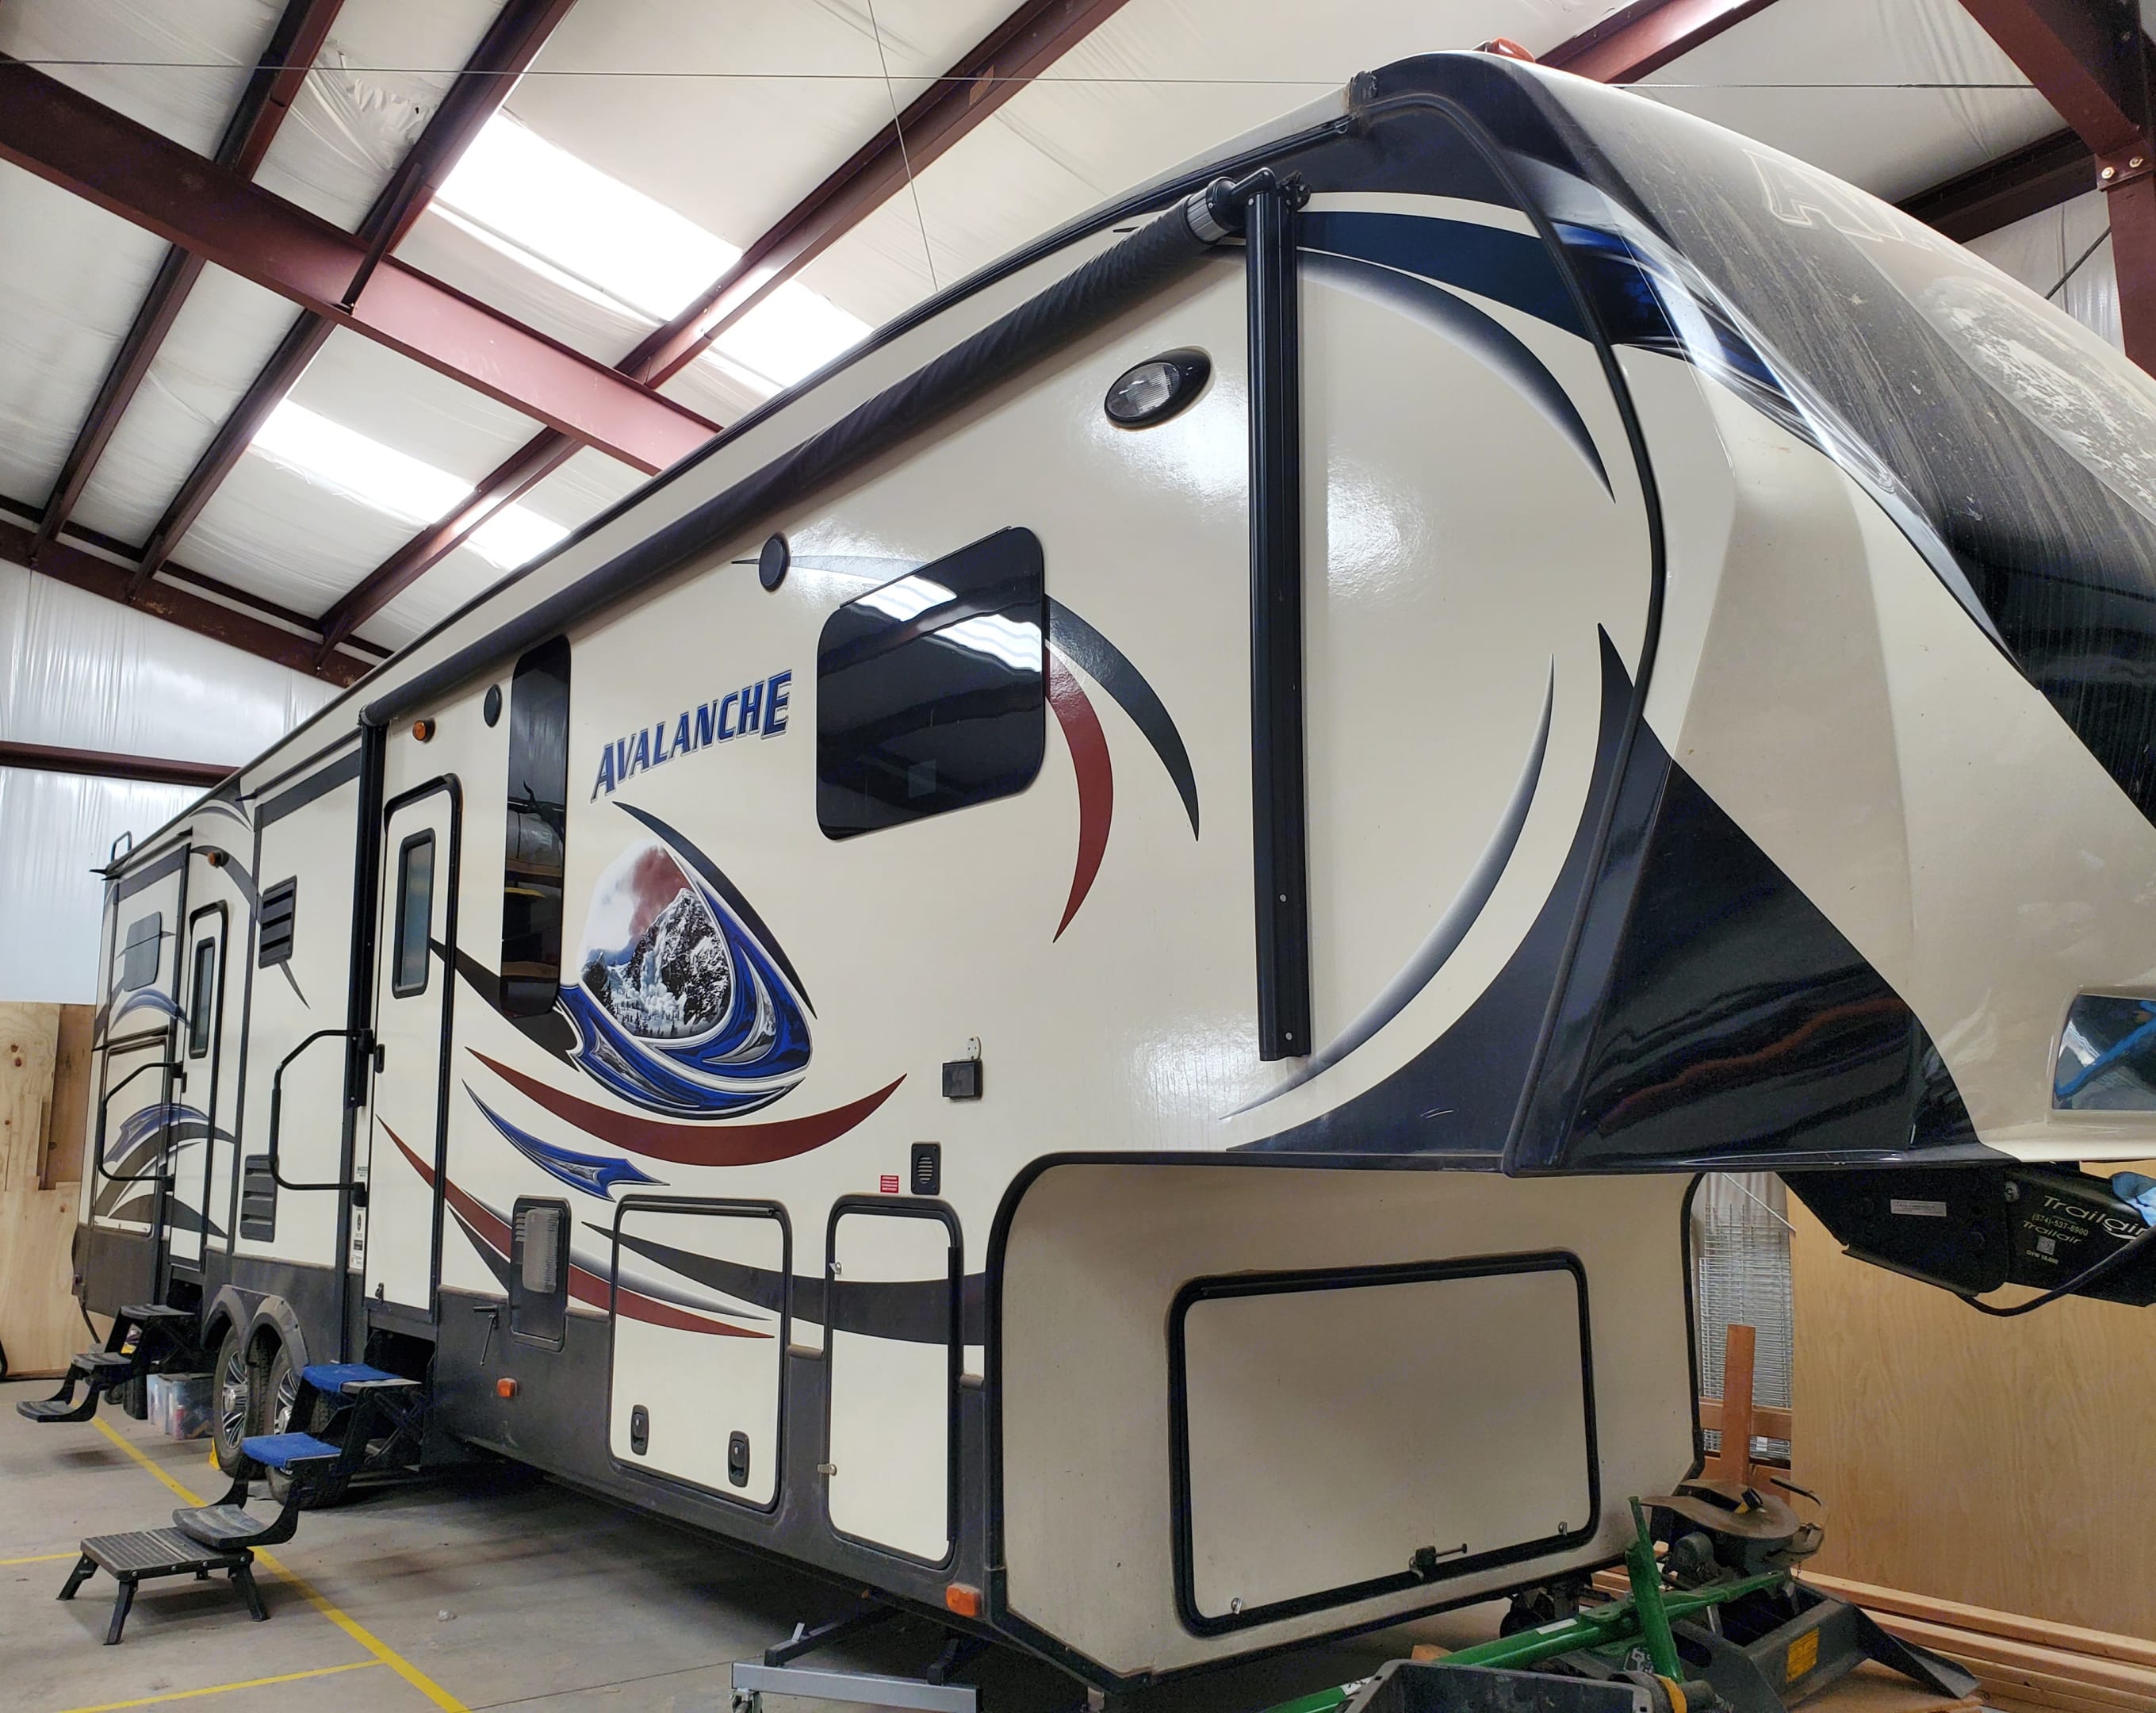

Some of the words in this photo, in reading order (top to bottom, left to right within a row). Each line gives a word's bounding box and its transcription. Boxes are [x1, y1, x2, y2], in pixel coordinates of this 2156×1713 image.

[590, 669, 793, 804] AVALANCHE
[2032, 1213, 2089, 1236] (574)-537-8900
[2043, 1195, 2147, 1236] Trailair
[2023, 1220, 2081, 1244] Trailair
